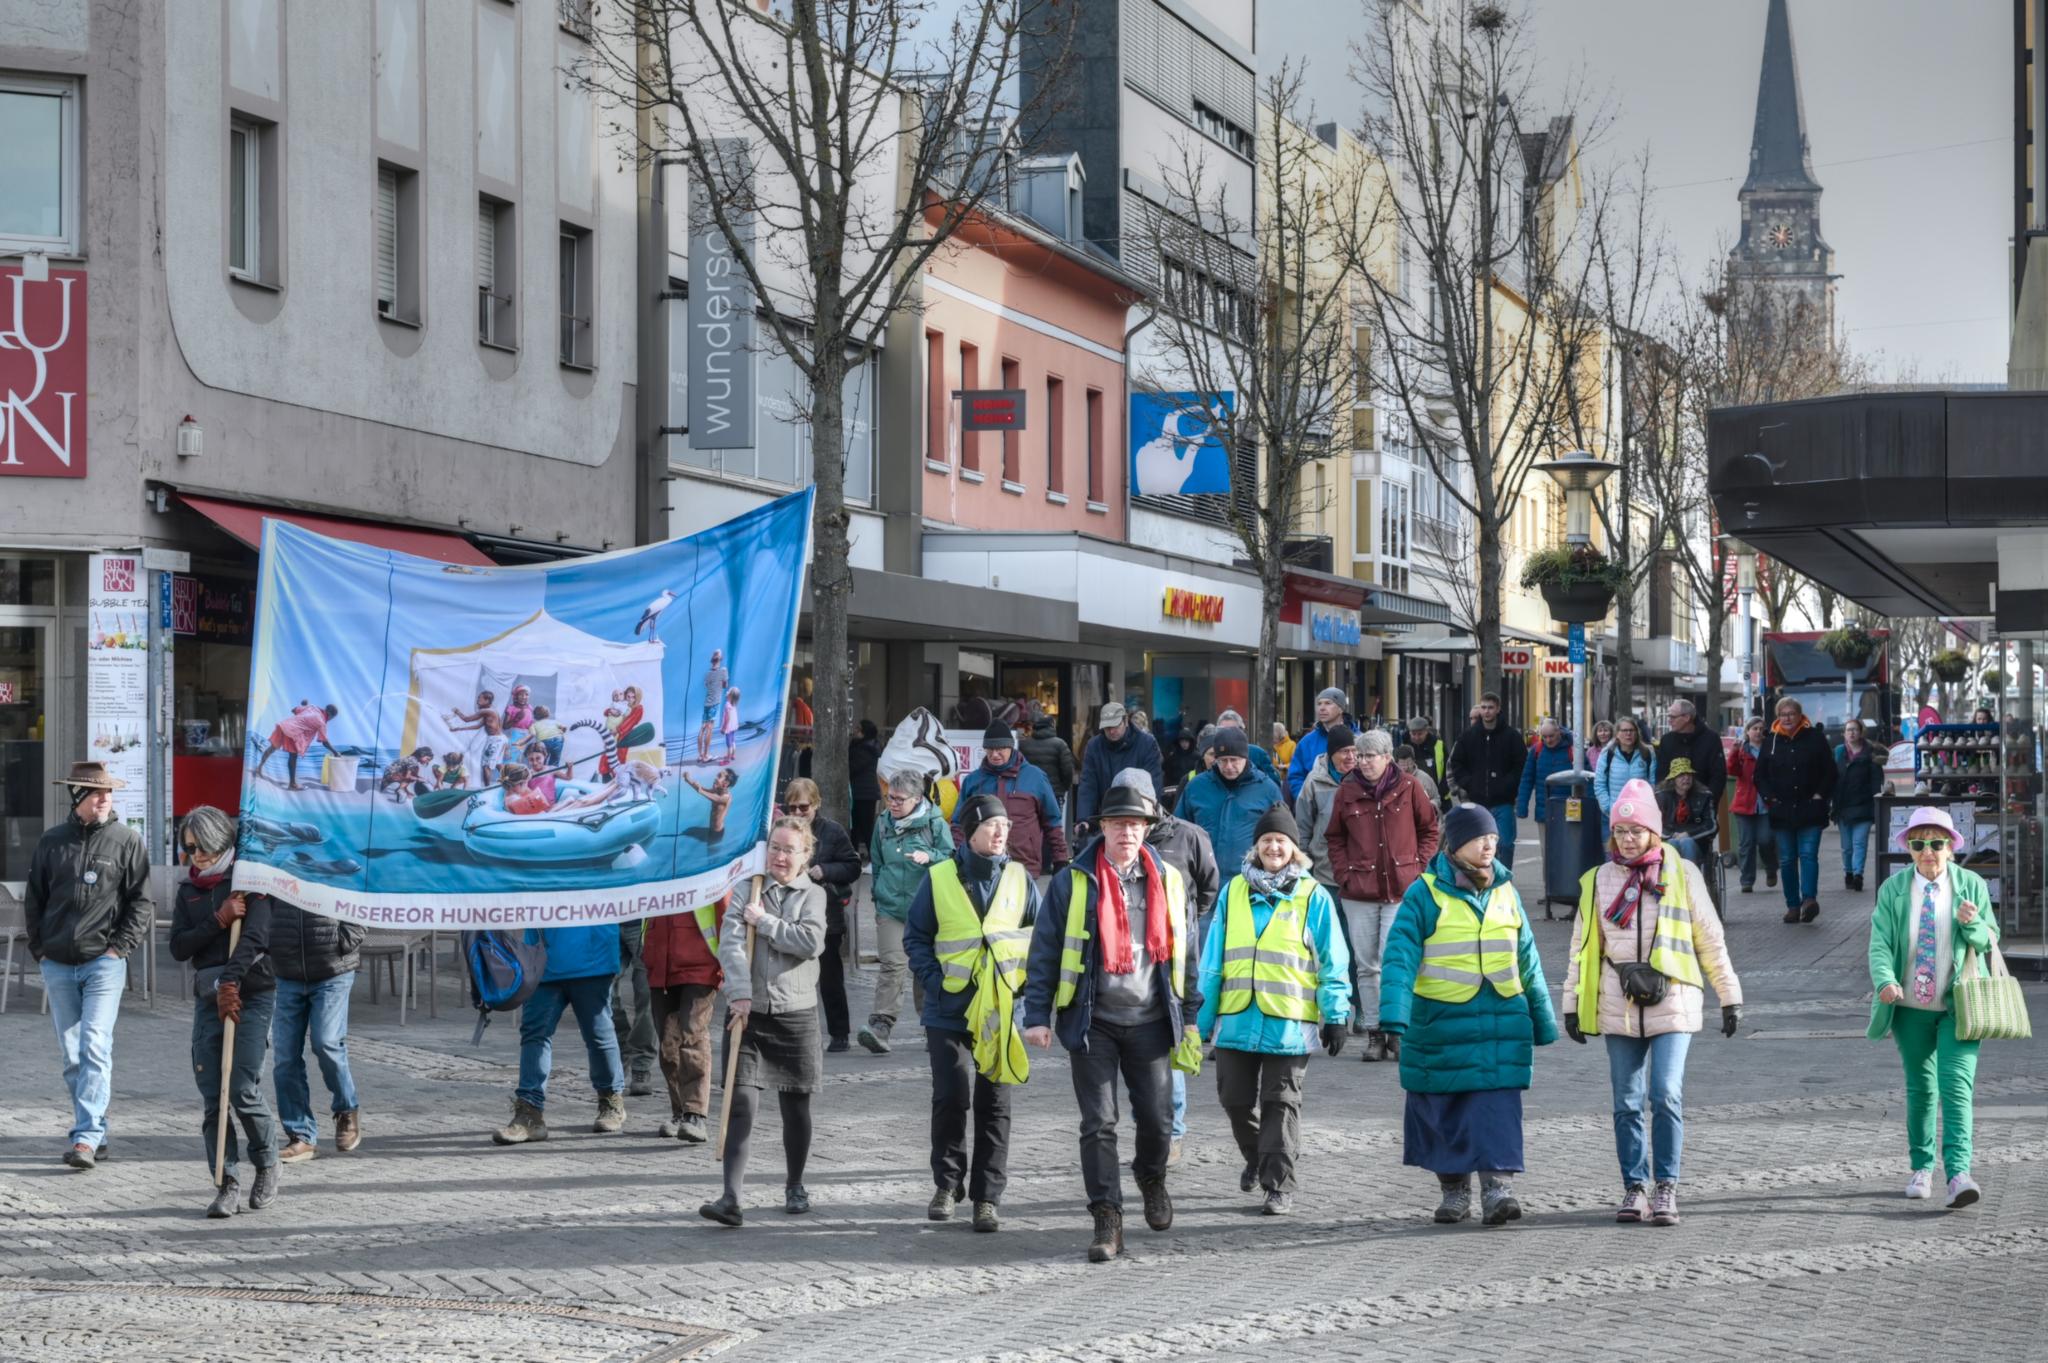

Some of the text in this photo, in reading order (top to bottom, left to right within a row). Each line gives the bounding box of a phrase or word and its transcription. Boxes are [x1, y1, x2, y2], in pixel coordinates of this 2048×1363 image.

[89, 598, 127, 608] BUBBLE
[1500, 651, 1530, 665] KD
[1545, 661, 1574, 674] NK
[334, 888, 698, 924] MISEREOR HUNGERTUCHWALLFAHRT
